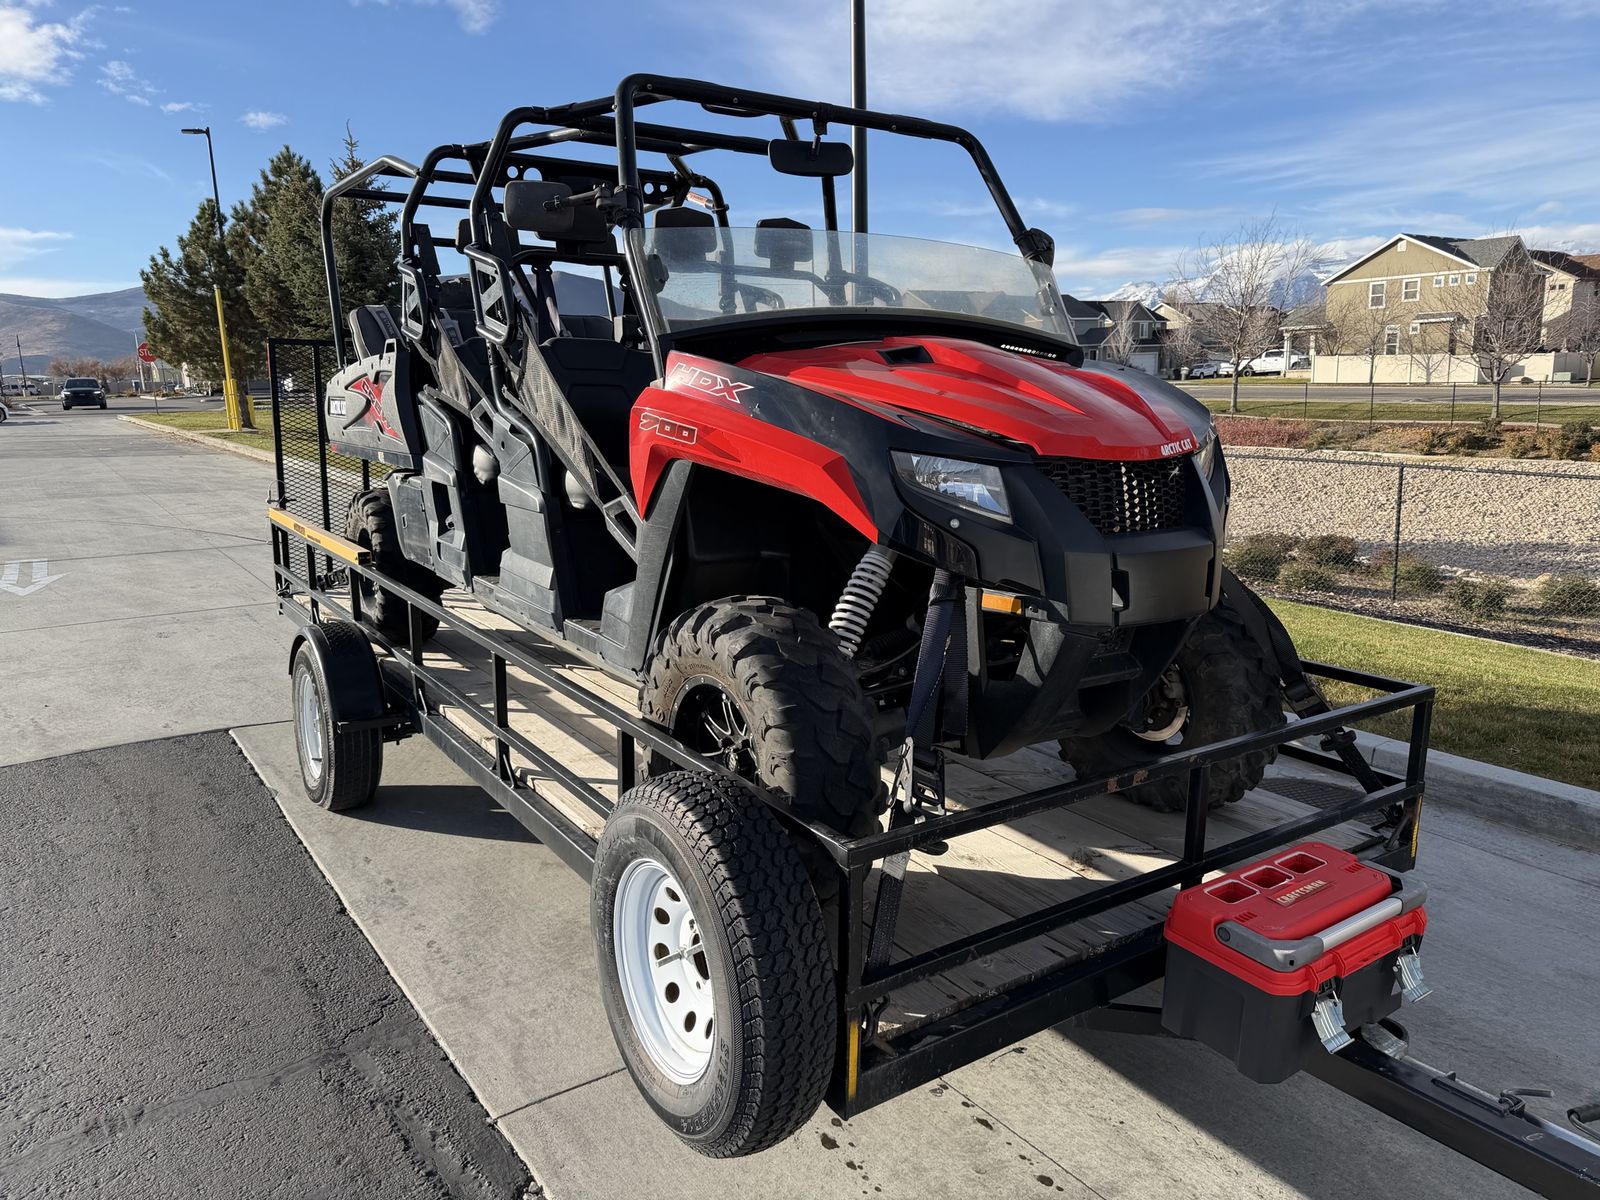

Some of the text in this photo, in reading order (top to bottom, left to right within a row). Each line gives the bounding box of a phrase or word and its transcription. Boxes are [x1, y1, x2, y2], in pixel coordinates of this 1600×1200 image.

[667, 362, 754, 403] HDX
[639, 412, 698, 444] 700
[1160, 438, 1193, 456] ARCTIC CAT
[1276, 879, 1328, 904] CRAFTSMAN
